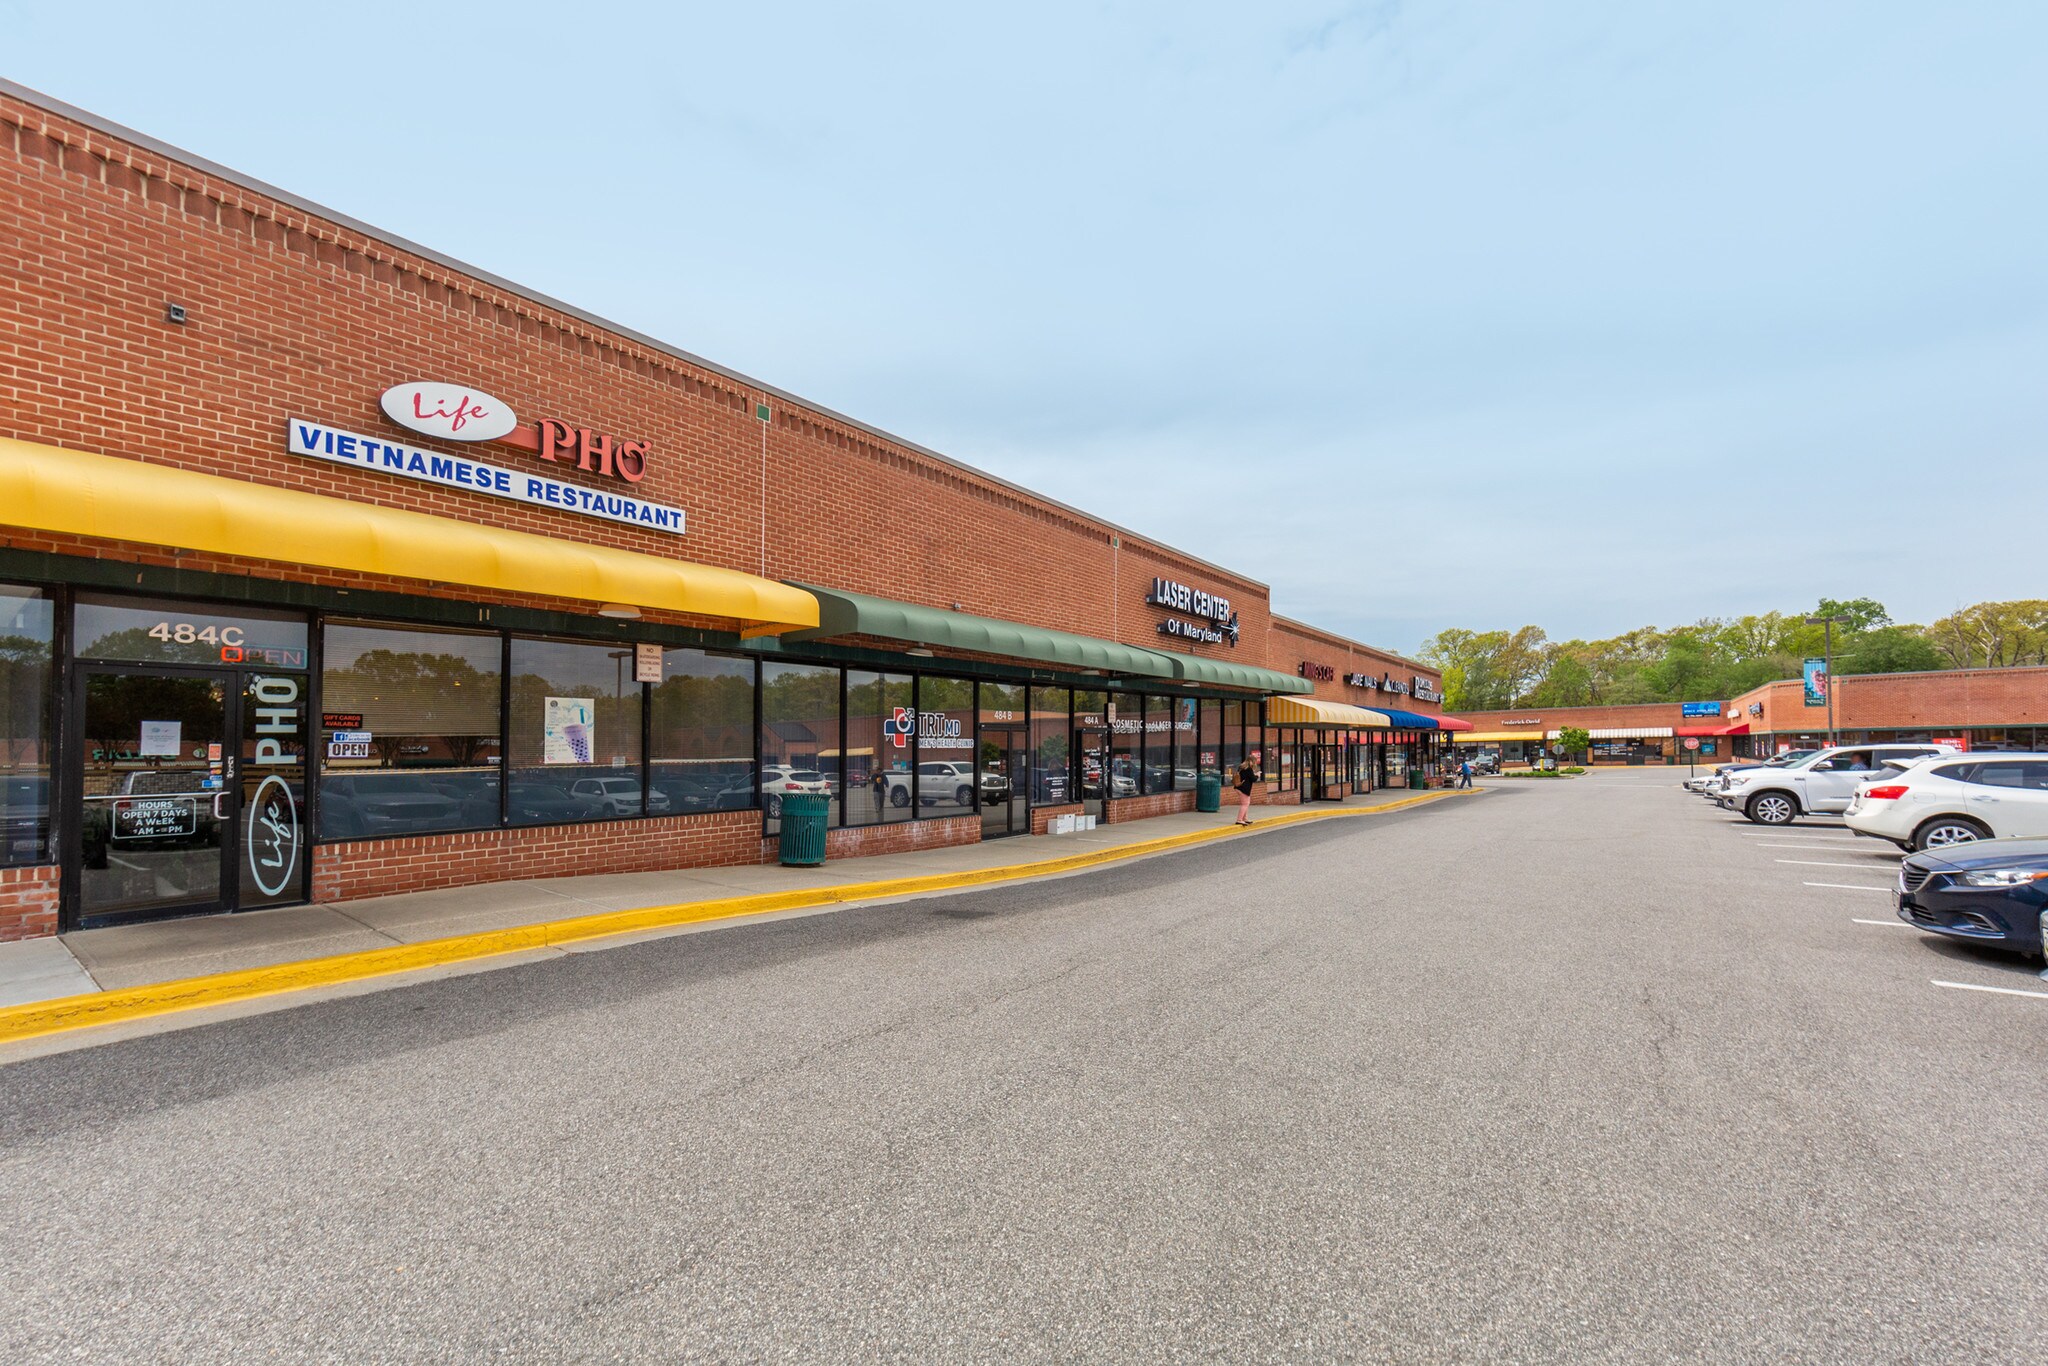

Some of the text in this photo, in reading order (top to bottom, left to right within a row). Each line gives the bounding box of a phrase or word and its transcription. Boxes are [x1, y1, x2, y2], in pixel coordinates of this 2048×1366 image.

[413, 392, 489, 431] Life
[299, 425, 682, 529] VIETNAMESE RESTAURANT
[1156, 577, 1230, 622] LASER CENTER
[148, 622, 245, 647] 484C
[1167, 618, 1222, 643] Of Maryland
[220, 646, 301, 665] OPEN
[1112, 719, 1143, 729] COSMETIC
[332, 743, 367, 756] OPEN
[937, 738, 957, 748] HEALTH
[957, 739, 975, 748] CLINIC
[122, 810, 151, 819] OPEN
[161, 808, 188, 817] DAYS
[138, 801, 174, 809] HOURS
[145, 817, 175, 826] WEEK
[260, 801, 292, 867] Life
